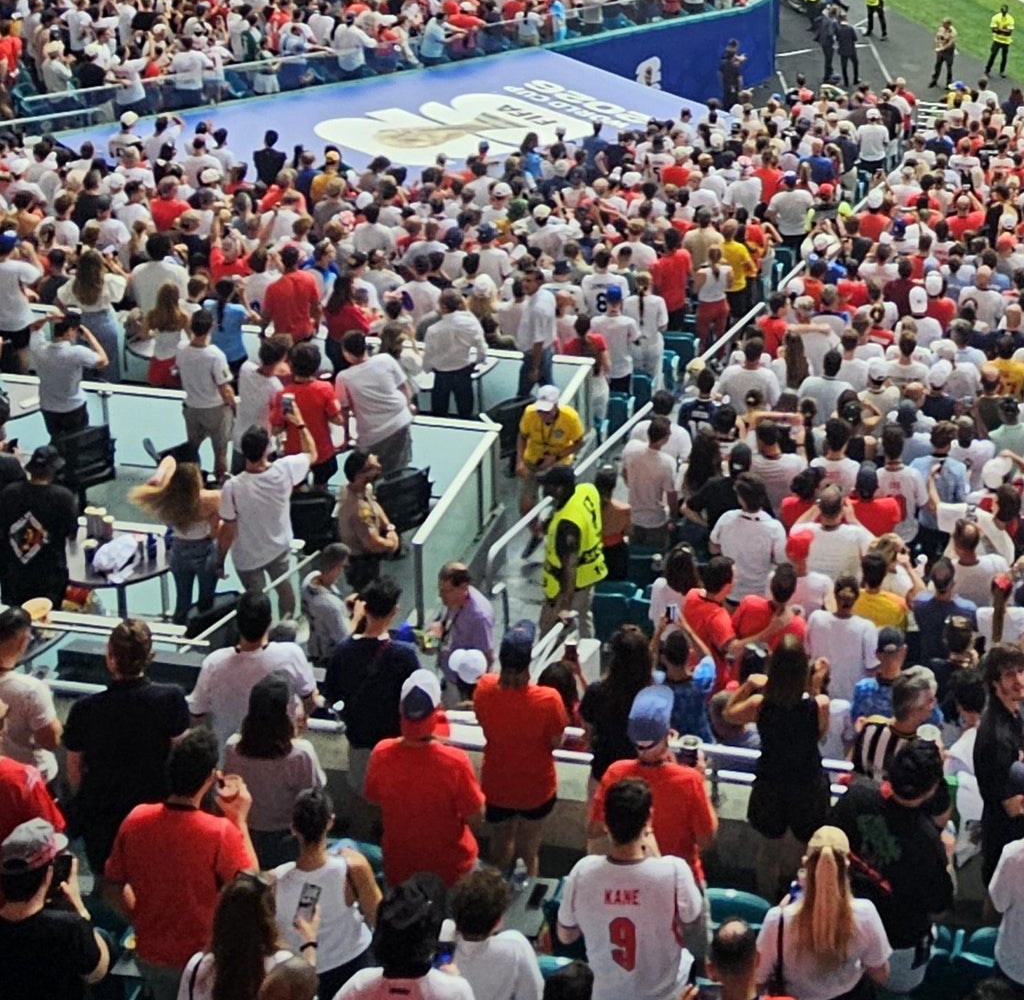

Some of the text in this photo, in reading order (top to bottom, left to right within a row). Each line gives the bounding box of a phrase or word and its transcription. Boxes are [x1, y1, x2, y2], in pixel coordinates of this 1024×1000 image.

[503, 85, 549, 101] CUP
[524, 80, 651, 124] 2026
[497, 104, 558, 126] FIFA
[604, 889, 640, 905] KANE
[609, 916, 636, 972] 9
